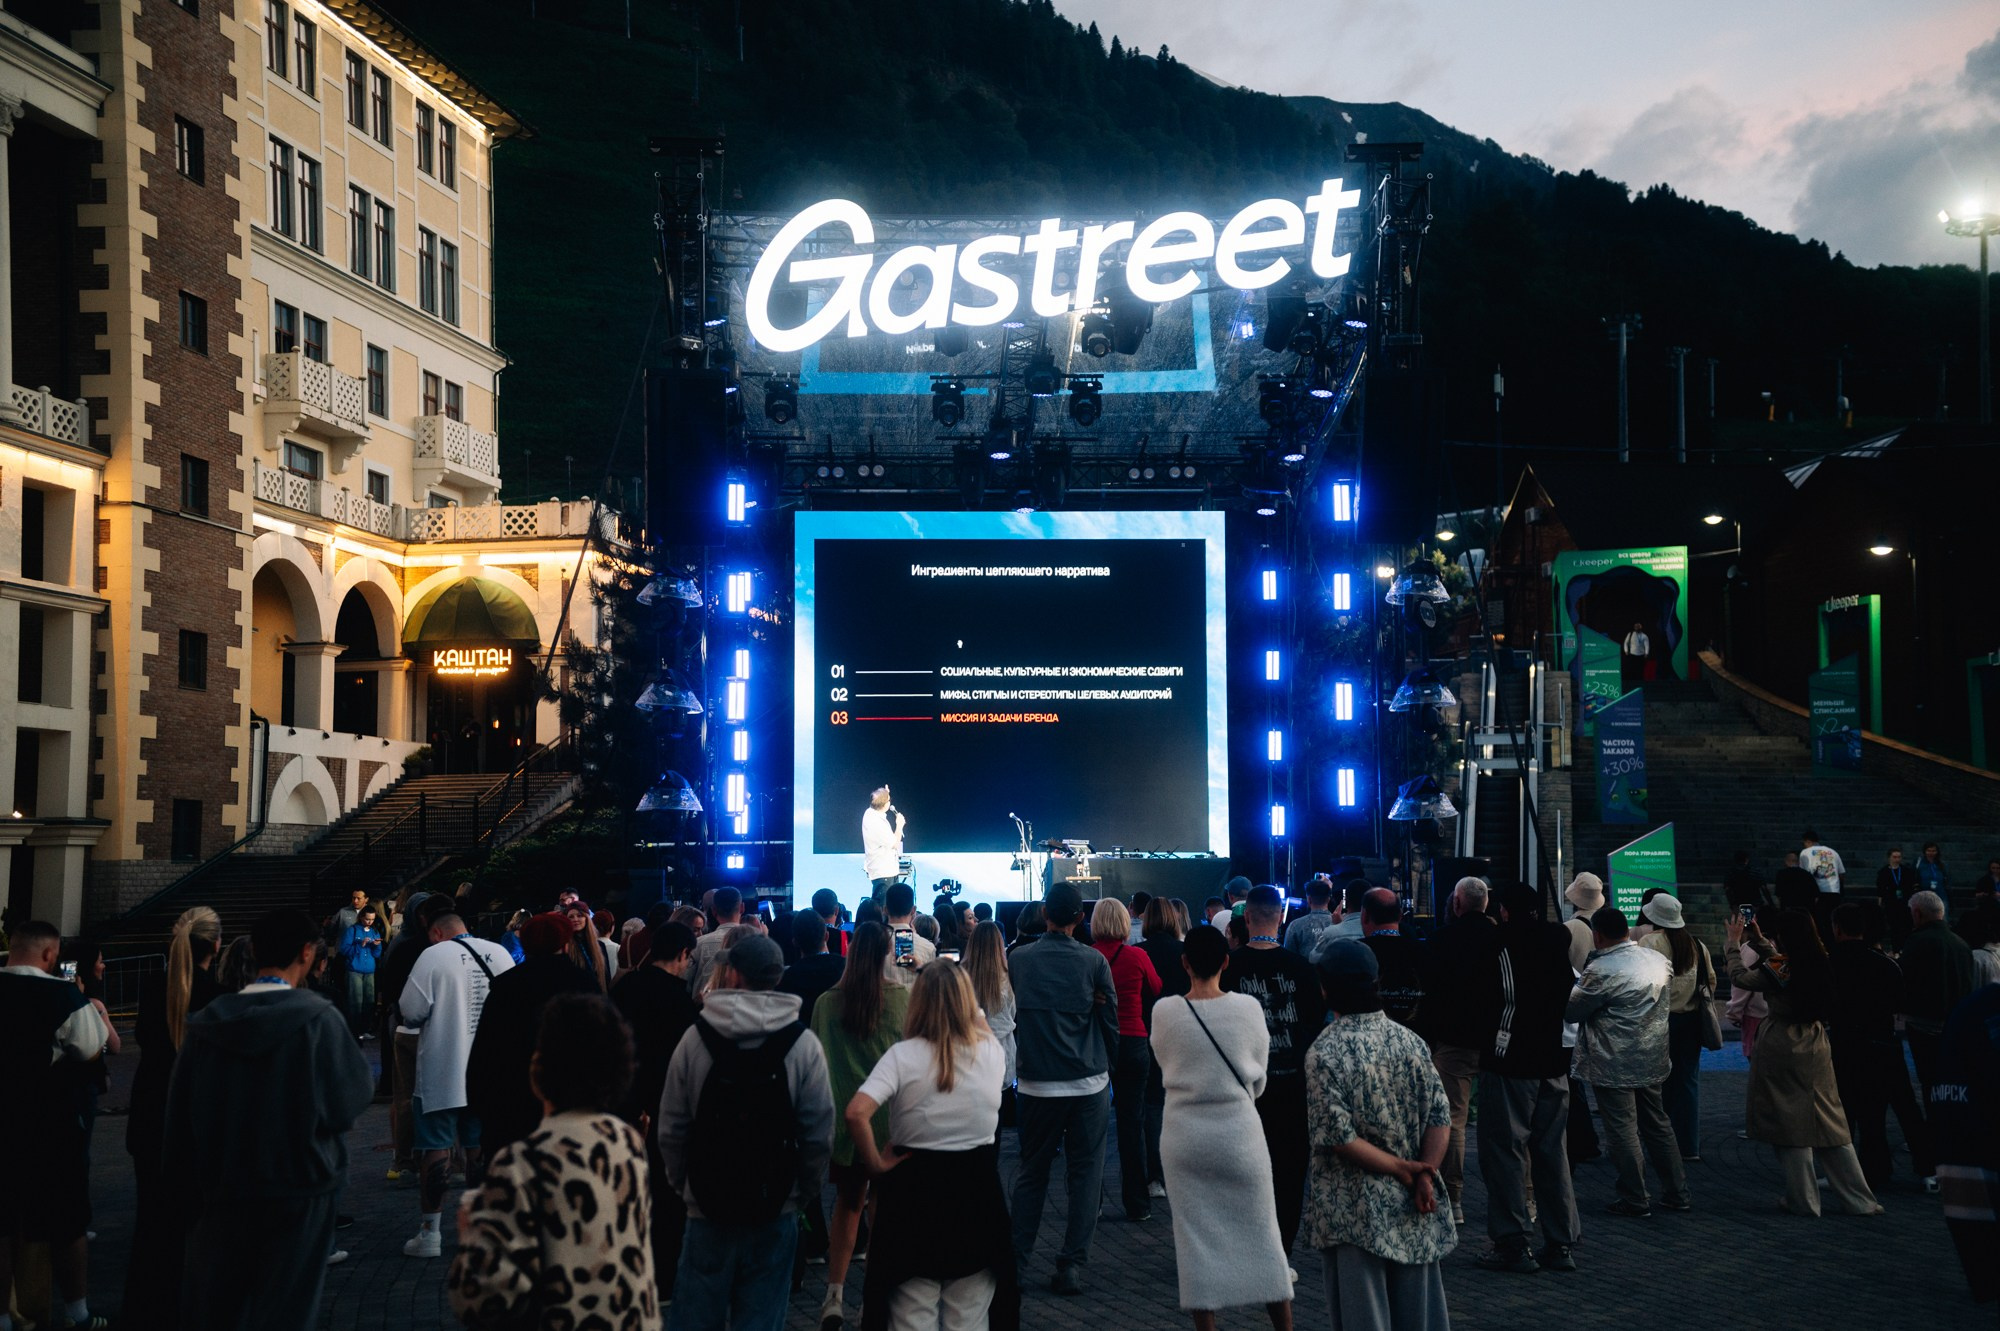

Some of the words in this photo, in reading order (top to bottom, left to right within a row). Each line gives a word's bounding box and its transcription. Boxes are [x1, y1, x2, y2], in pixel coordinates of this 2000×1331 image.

[745, 178, 1361, 353] Gastreet
[911, 564, 983, 579] Ингредиенты
[985, 567, 1053, 576] цепляющего
[1054, 567, 1110, 579] нарратива
[1825, 594, 1860, 612] r_keeper
[433, 648, 512, 667] КАШТАН
[830, 664, 844, 678] 01
[940, 667, 1003, 677] СОЦИАЛЬНЫЕ,
[1003, 667, 1061, 676] КУЛЬТУРНЫЕ
[1062, 667, 1068, 676] И
[1069, 667, 1147, 676] ЭКОНОМИЧЕСКИЕ
[1147, 667, 1183, 676] СДВИГИ
[830, 687, 848, 702] 02
[940, 690, 971, 700] МИФЫ,
[972, 690, 1010, 699] СТИГМЫ
[1010, 690, 1018, 699] И
[1018, 690, 1076, 699] СТЕРЕОТИПЫ
[1077, 690, 1119, 699] ЦЕЛЕВЫХ
[1119, 688, 1172, 699] АУДИТОРИЙ
[1584, 681, 1620, 698] +23%
[830, 711, 848, 726] 03
[941, 713, 978, 723] МИССИЯ
[979, 713, 986, 722] И
[987, 713, 1023, 723] ЗАДАЧИ
[1023, 713, 1059, 723] БРЕНДА
[1602, 739, 1635, 747] ЧАСТОТА
[1602, 747, 1634, 755] ЗАКАЗОВ
[1602, 756, 1645, 776] +30%
[1272, 972, 1296, 994] the
